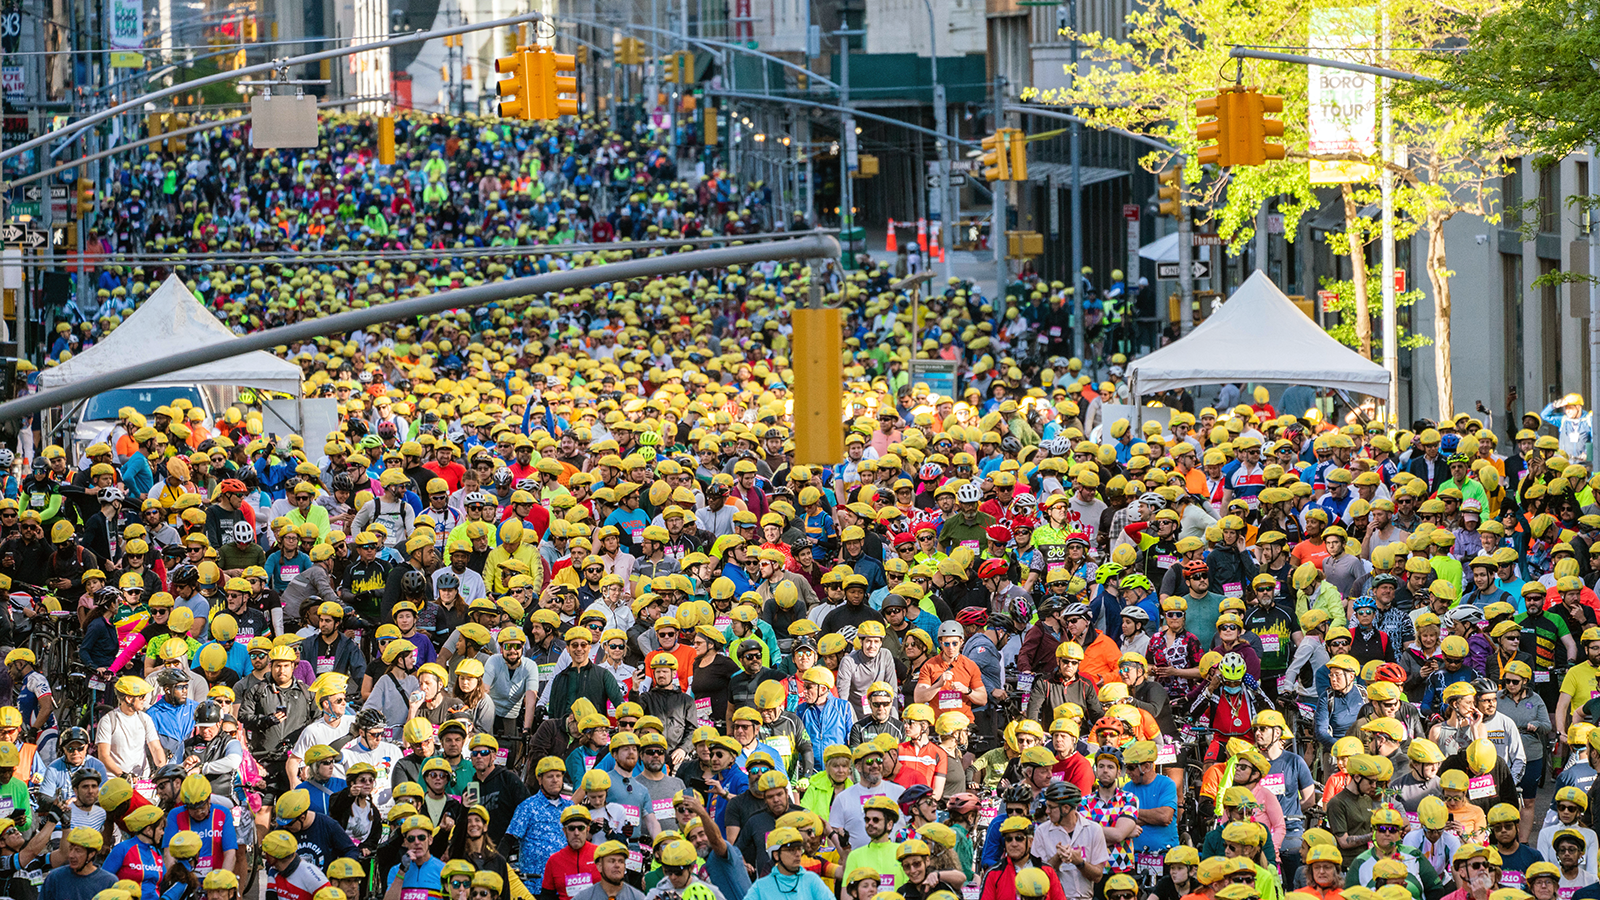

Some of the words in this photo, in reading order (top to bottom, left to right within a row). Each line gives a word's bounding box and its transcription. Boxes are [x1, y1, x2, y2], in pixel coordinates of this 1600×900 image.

[1320, 76, 1364, 89] BORO
[1321, 104, 1363, 117] TOUR
[1195, 235, 1222, 245] Thomas
[403, 892, 426, 900] 25742
